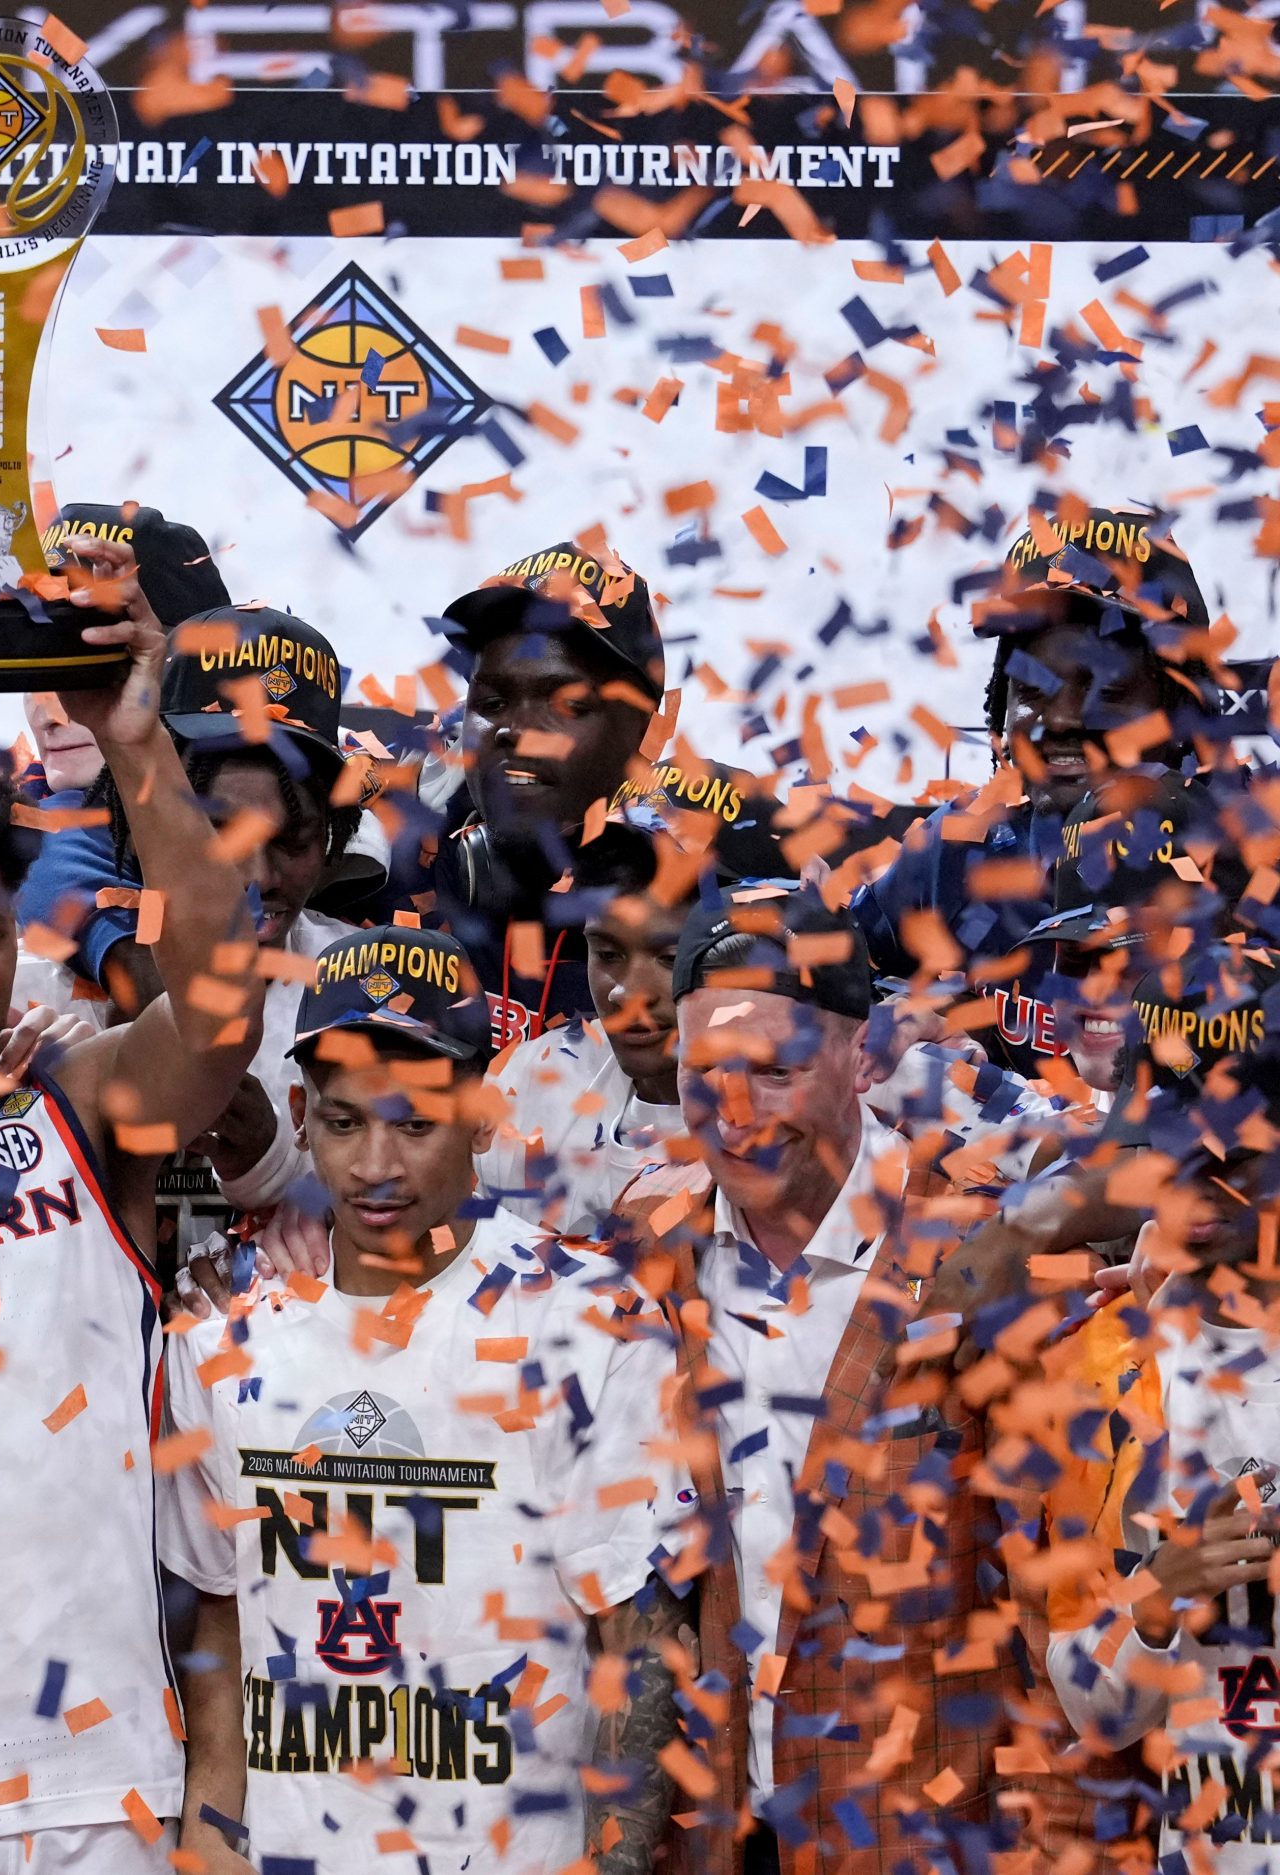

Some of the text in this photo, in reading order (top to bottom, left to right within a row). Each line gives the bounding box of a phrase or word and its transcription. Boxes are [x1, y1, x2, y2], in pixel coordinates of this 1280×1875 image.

[218, 143, 519, 186] INVITATION
[541, 144, 901, 188] TOURNAMENT
[43, 160, 105, 242] BEGINNING
[1010, 518, 1152, 572] CHMPIONS
[200, 634, 337, 700] CHAMPIONS
[314, 942, 459, 994] CHAMPIONS
[368, 982, 392, 990] NIT
[248, 1456, 484, 1483] 2026 NATIONAL INVITATION TOURNAMENT
[255, 1485, 479, 1585] NIT
